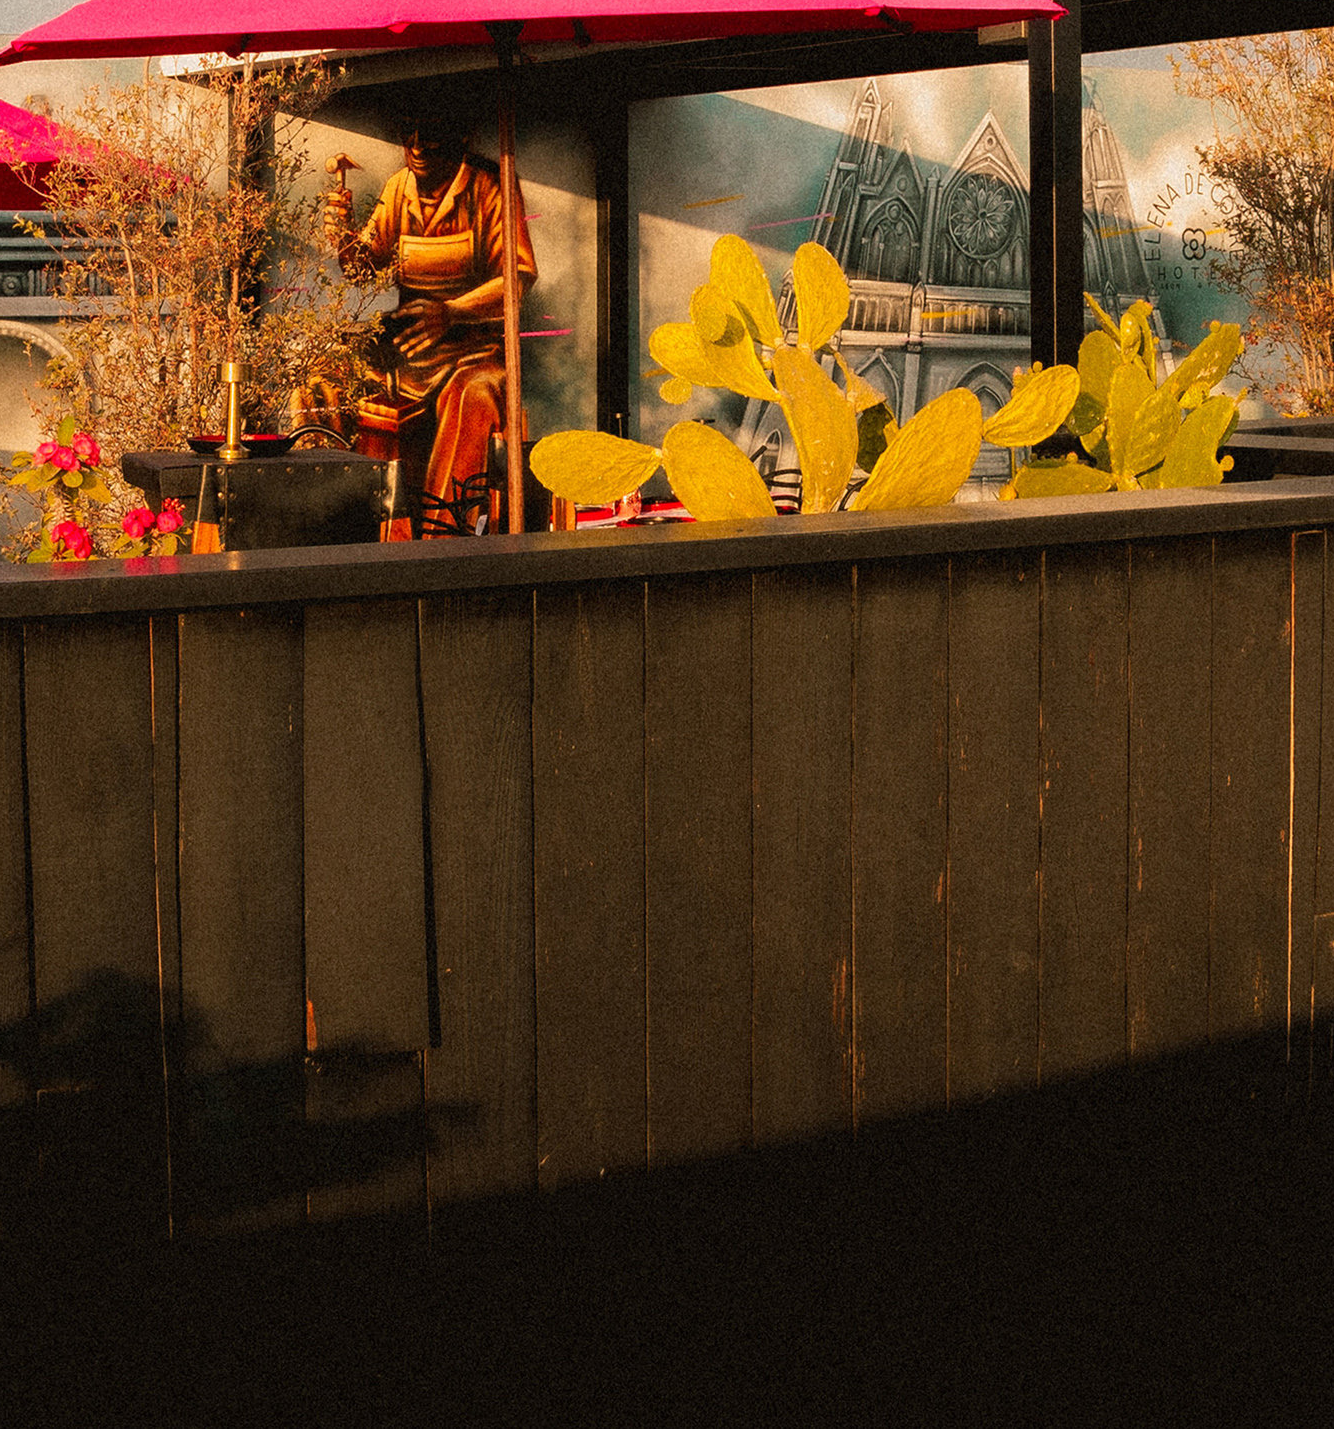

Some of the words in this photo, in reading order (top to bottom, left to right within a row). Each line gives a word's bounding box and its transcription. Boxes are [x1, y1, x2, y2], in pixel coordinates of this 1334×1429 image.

[1144, 183, 1181, 262] ELENA
[1184, 172, 1204, 195] DE
[1157, 266, 1218, 281] HOTE
